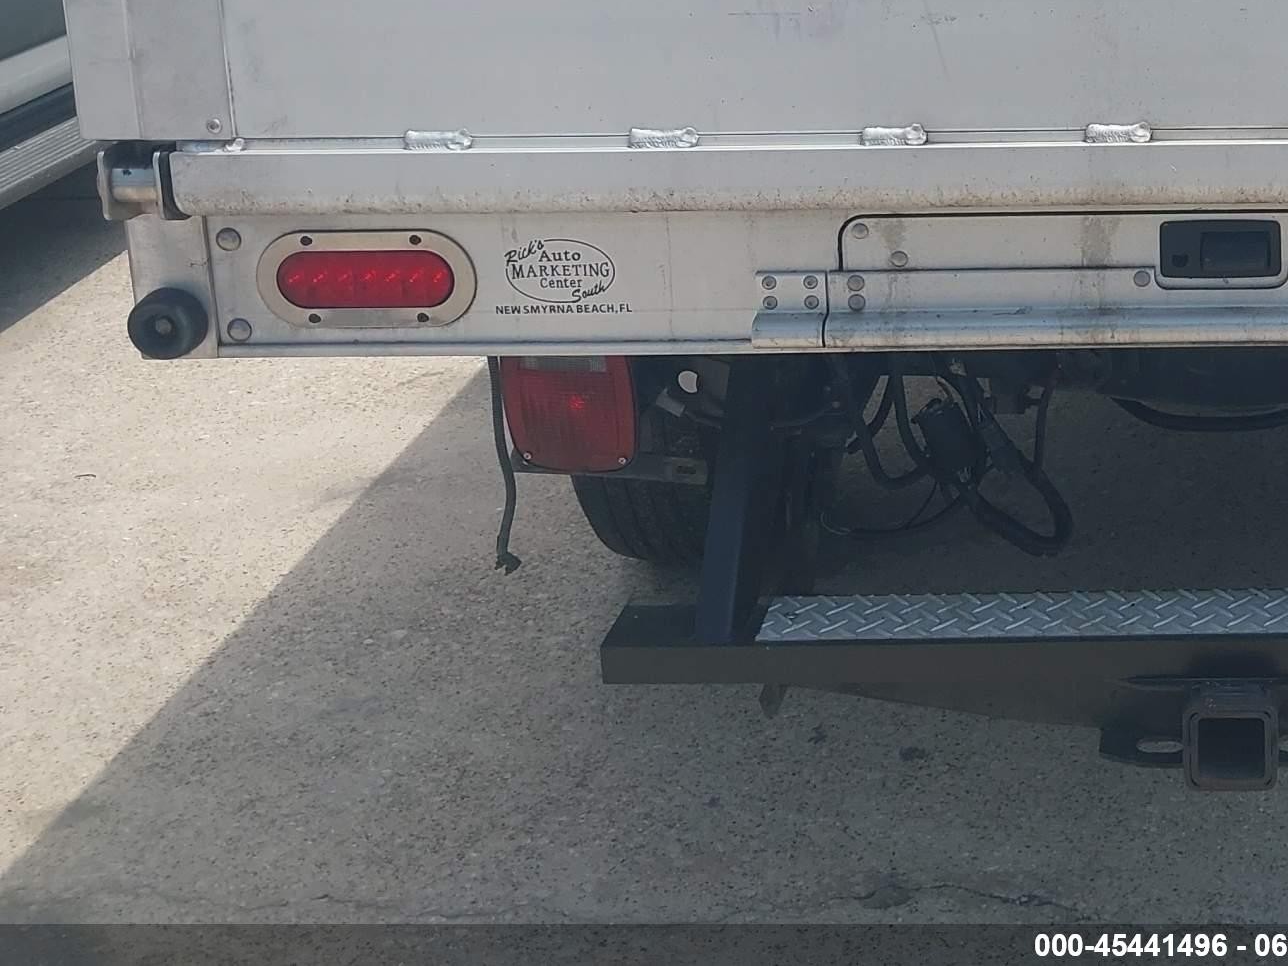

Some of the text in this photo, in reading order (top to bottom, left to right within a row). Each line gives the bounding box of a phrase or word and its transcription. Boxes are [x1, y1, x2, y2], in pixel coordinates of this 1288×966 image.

[504, 239, 545, 266] Rick's
[538, 250, 581, 262] Auto
[511, 262, 610, 280] MARKETING
[540, 277, 583, 289] Center
[571, 280, 607, 302] South
[496, 305, 521, 315] NEW
[523, 304, 574, 314] SMYRNA
